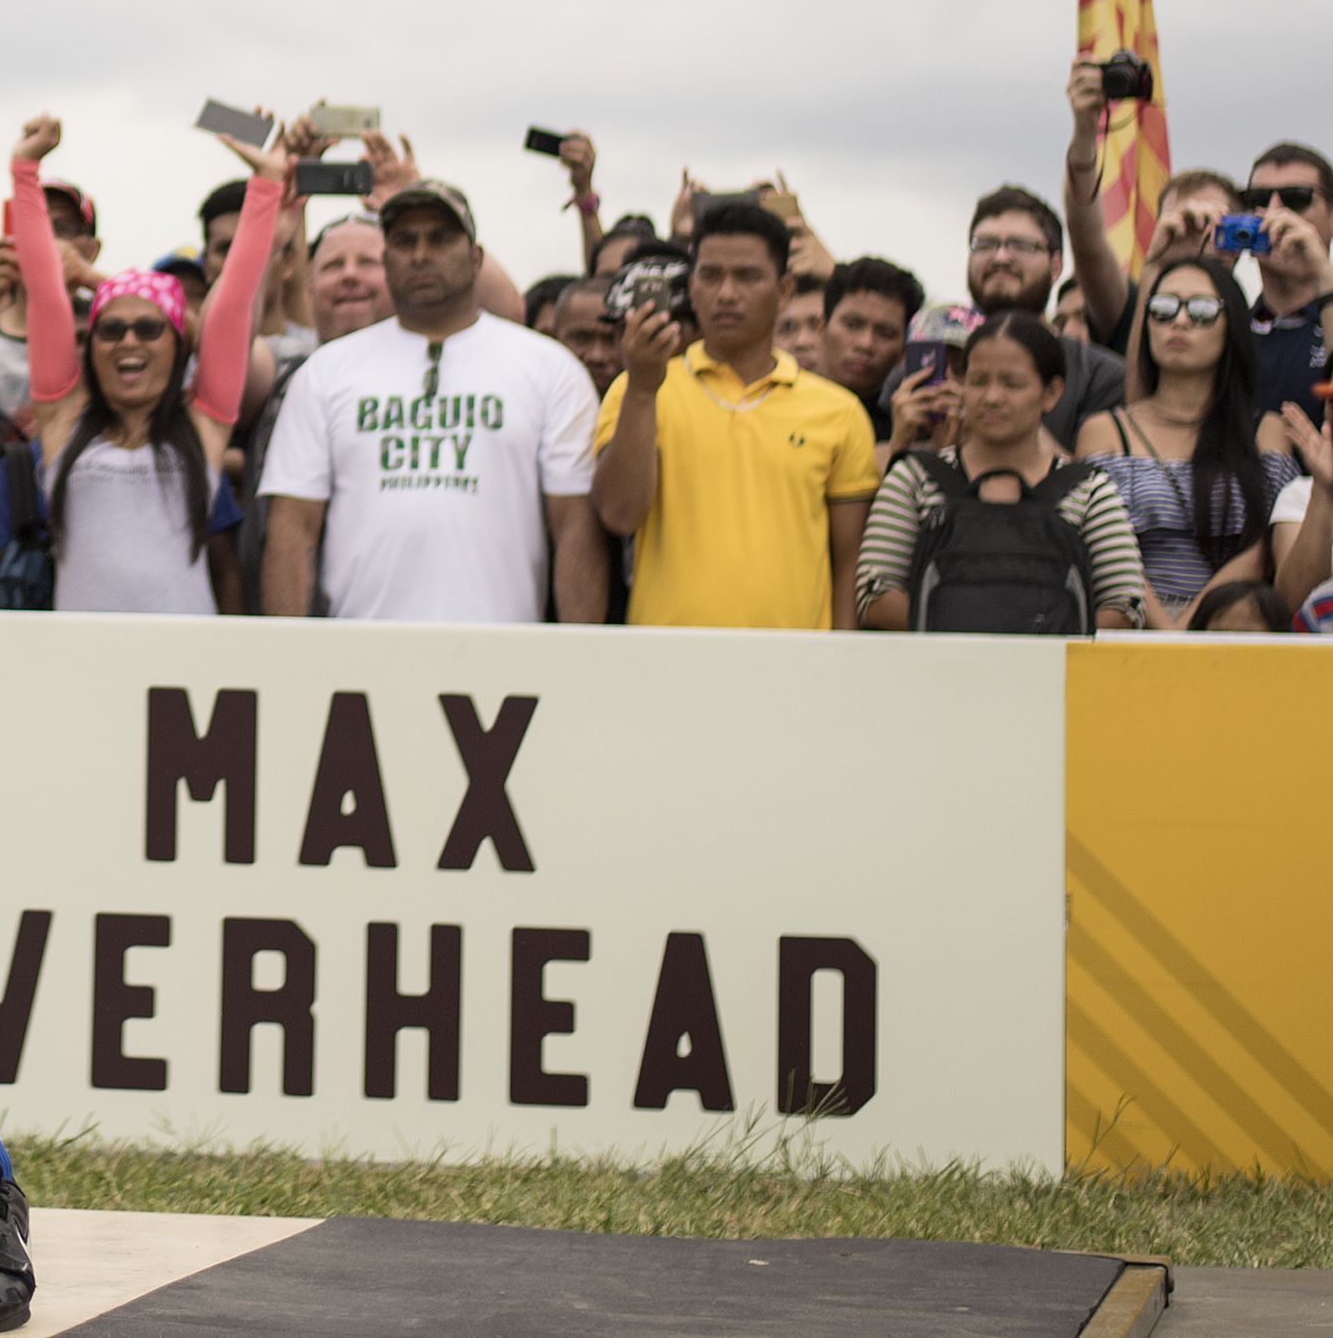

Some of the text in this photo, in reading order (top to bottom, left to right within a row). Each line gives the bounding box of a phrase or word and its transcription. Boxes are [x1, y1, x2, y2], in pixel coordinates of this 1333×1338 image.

[357, 394, 504, 432] BAGUIO
[379, 434, 472, 471] CITY
[145, 686, 539, 873] MAX
